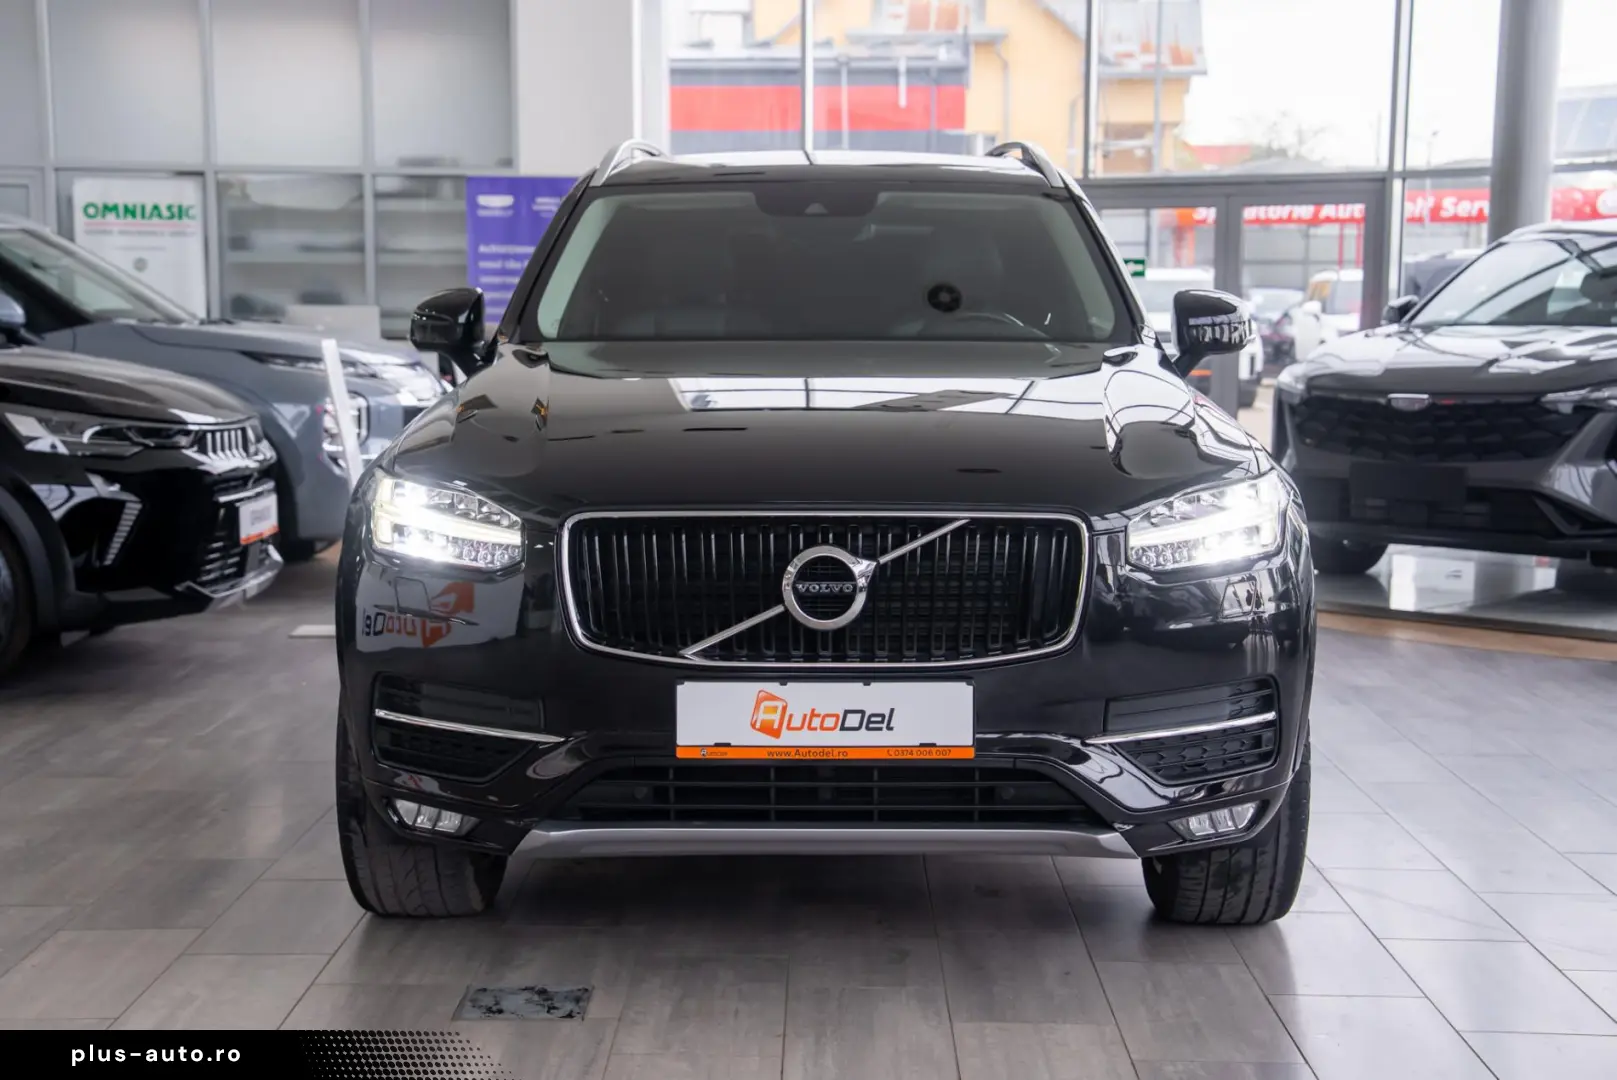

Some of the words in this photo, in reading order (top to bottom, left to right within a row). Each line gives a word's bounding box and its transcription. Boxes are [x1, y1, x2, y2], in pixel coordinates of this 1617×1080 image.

[1319, 203, 1366, 220] Aut
[796, 583, 854, 593] VOLVO
[751, 691, 895, 738] AutoDel
[767, 748, 848, 758] www.Autodel.ro
